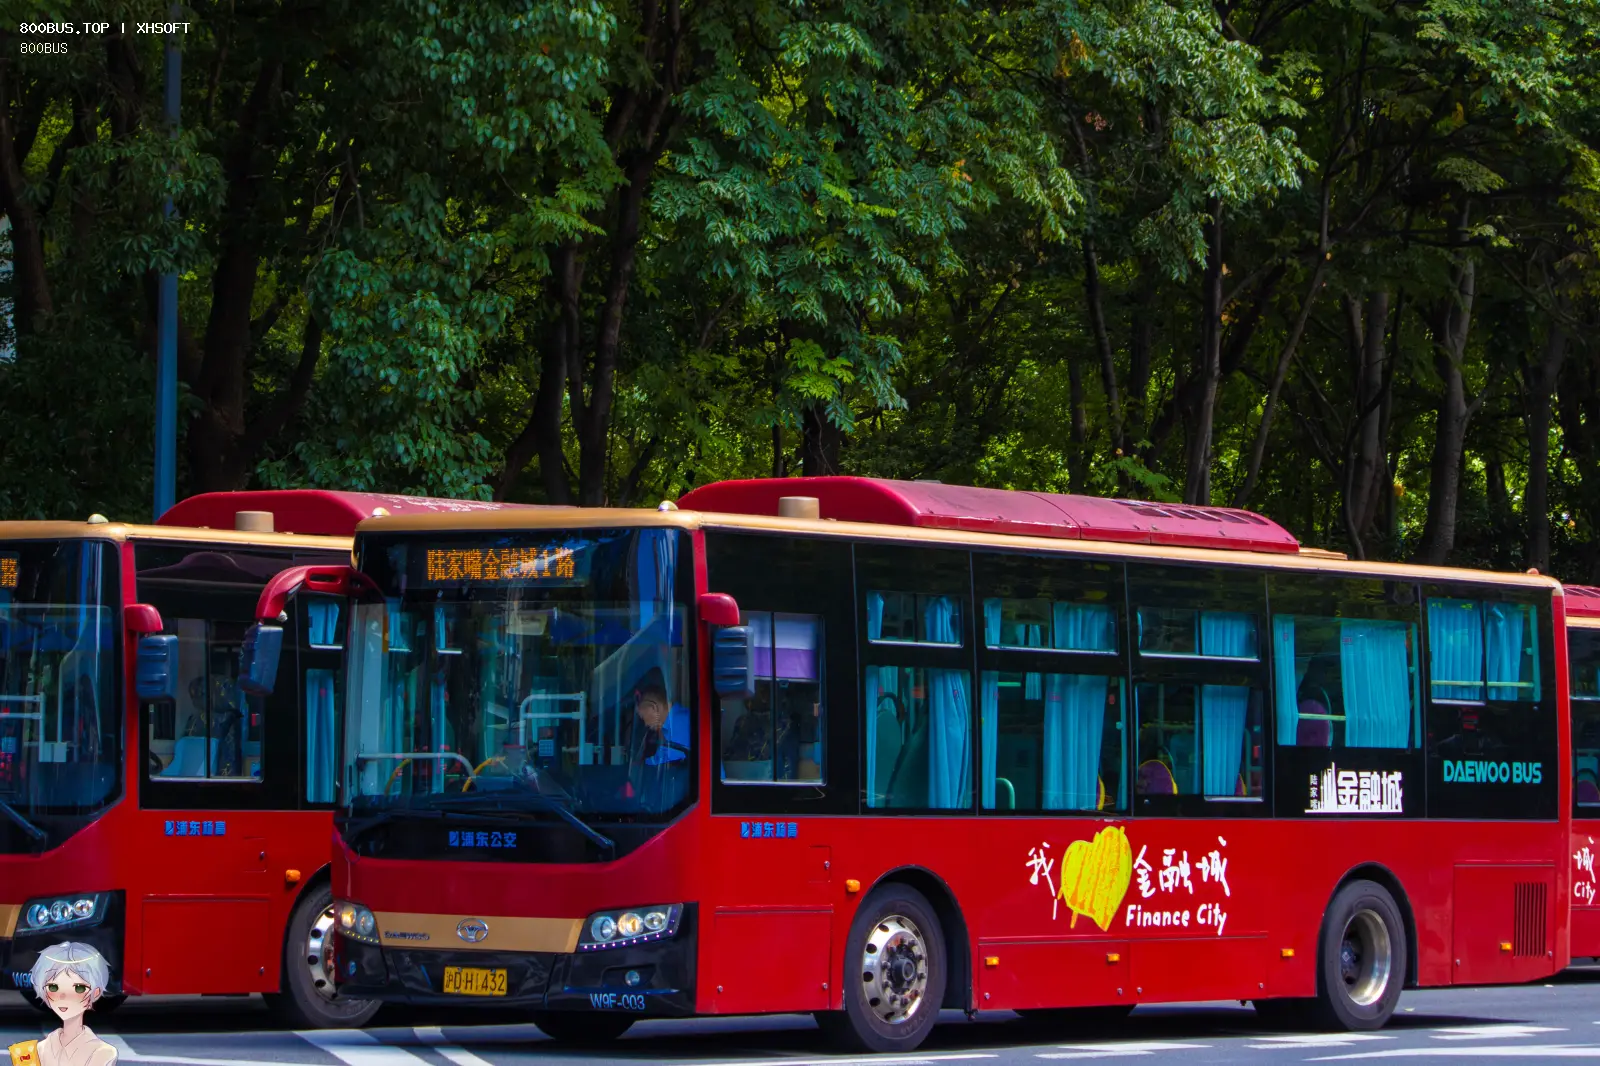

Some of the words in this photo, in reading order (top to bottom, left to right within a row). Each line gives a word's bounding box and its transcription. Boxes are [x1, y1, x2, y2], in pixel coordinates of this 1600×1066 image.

[1443, 760, 1510, 783] DAEWOO
[1512, 761, 1542, 784] BUS
[1337, 770, 1403, 812] 金融城
[461, 831, 517, 848] 浦东公交
[1025, 841, 1056, 897] 我
[1133, 835, 1231, 898] 金融城
[1573, 881, 1596, 906] City
[1125, 904, 1190, 927] Finance
[1196, 902, 1227, 936] City
[589, 993, 646, 1010] W9F-003
